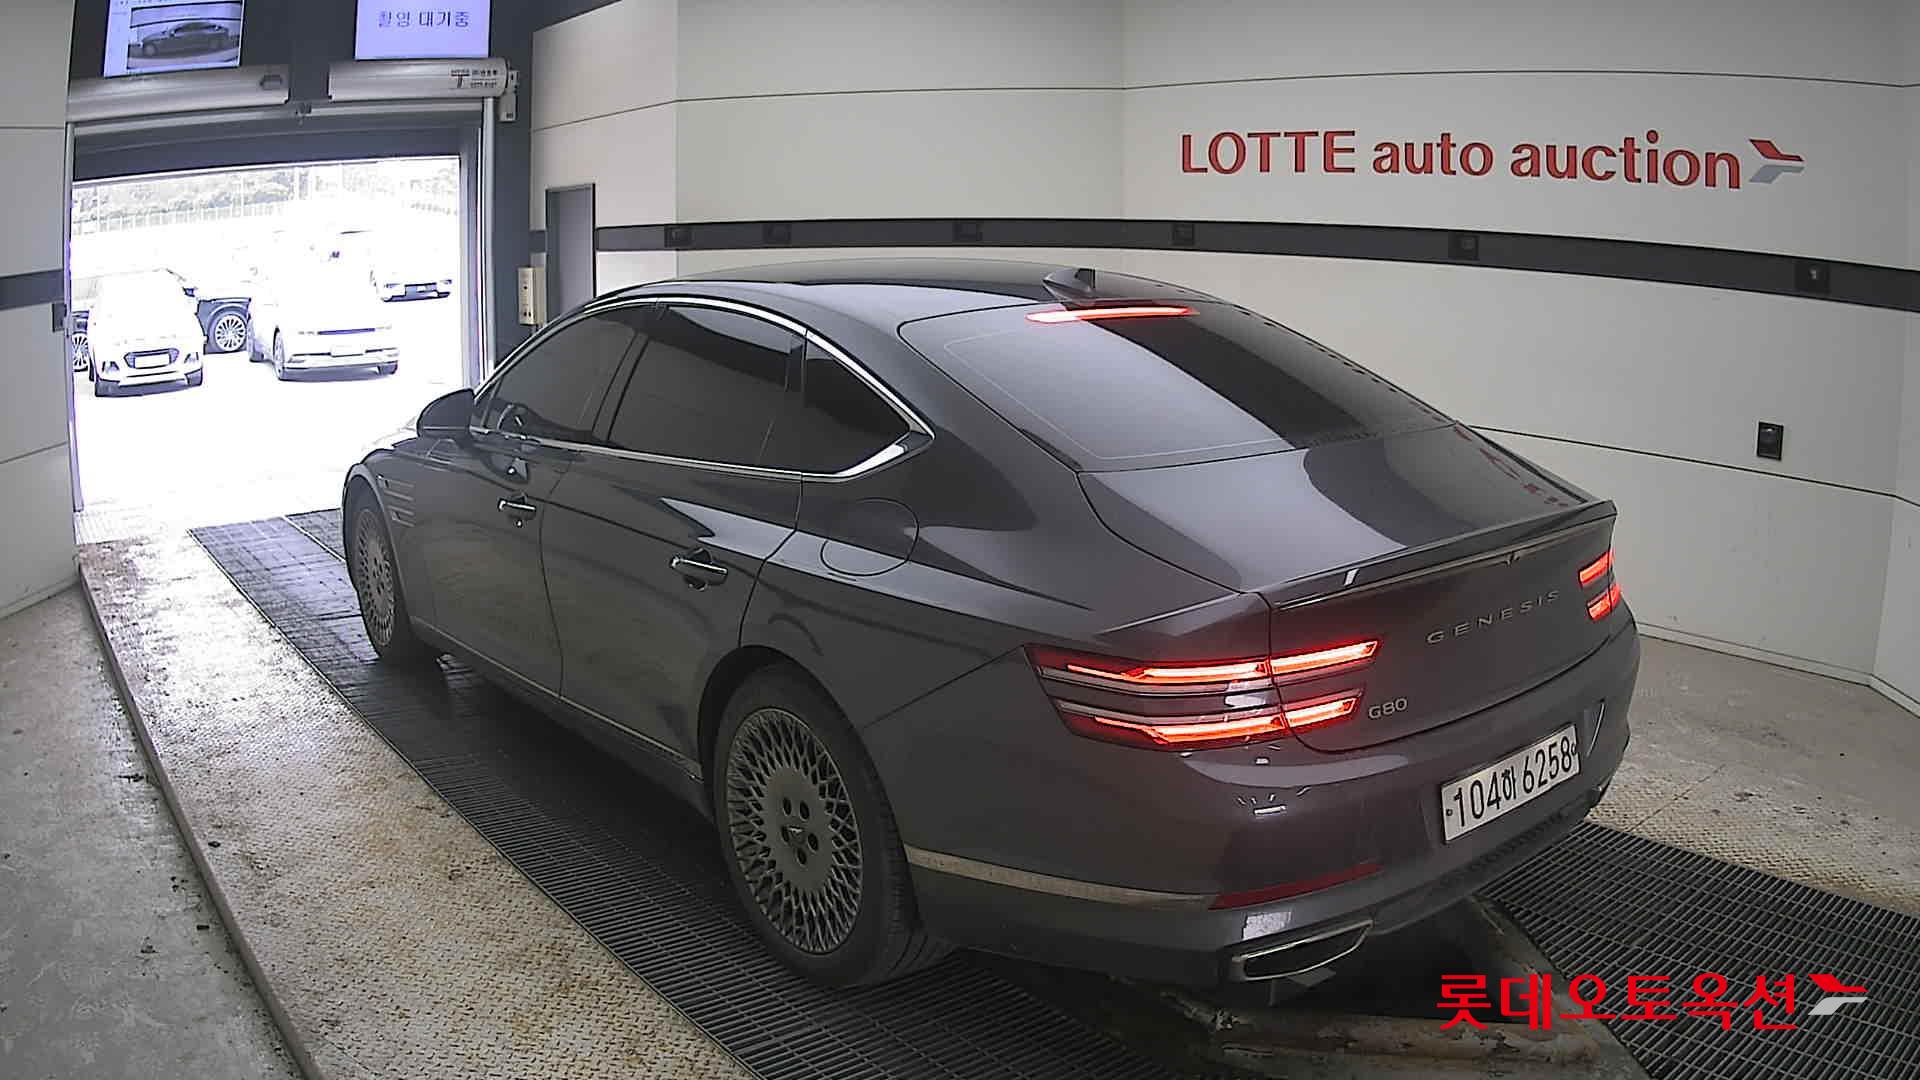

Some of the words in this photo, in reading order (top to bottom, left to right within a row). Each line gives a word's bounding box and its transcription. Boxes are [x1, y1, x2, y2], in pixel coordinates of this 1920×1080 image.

[419, 11, 469, 27] 대기중
[1181, 130, 1356, 174] LOTTE
[1372, 131, 1495, 177] auto
[1510, 131, 1742, 190] auction
[1426, 590, 1560, 645] GENESIS
[1368, 697, 1408, 720] G80
[1522, 735, 1573, 794] 6258
